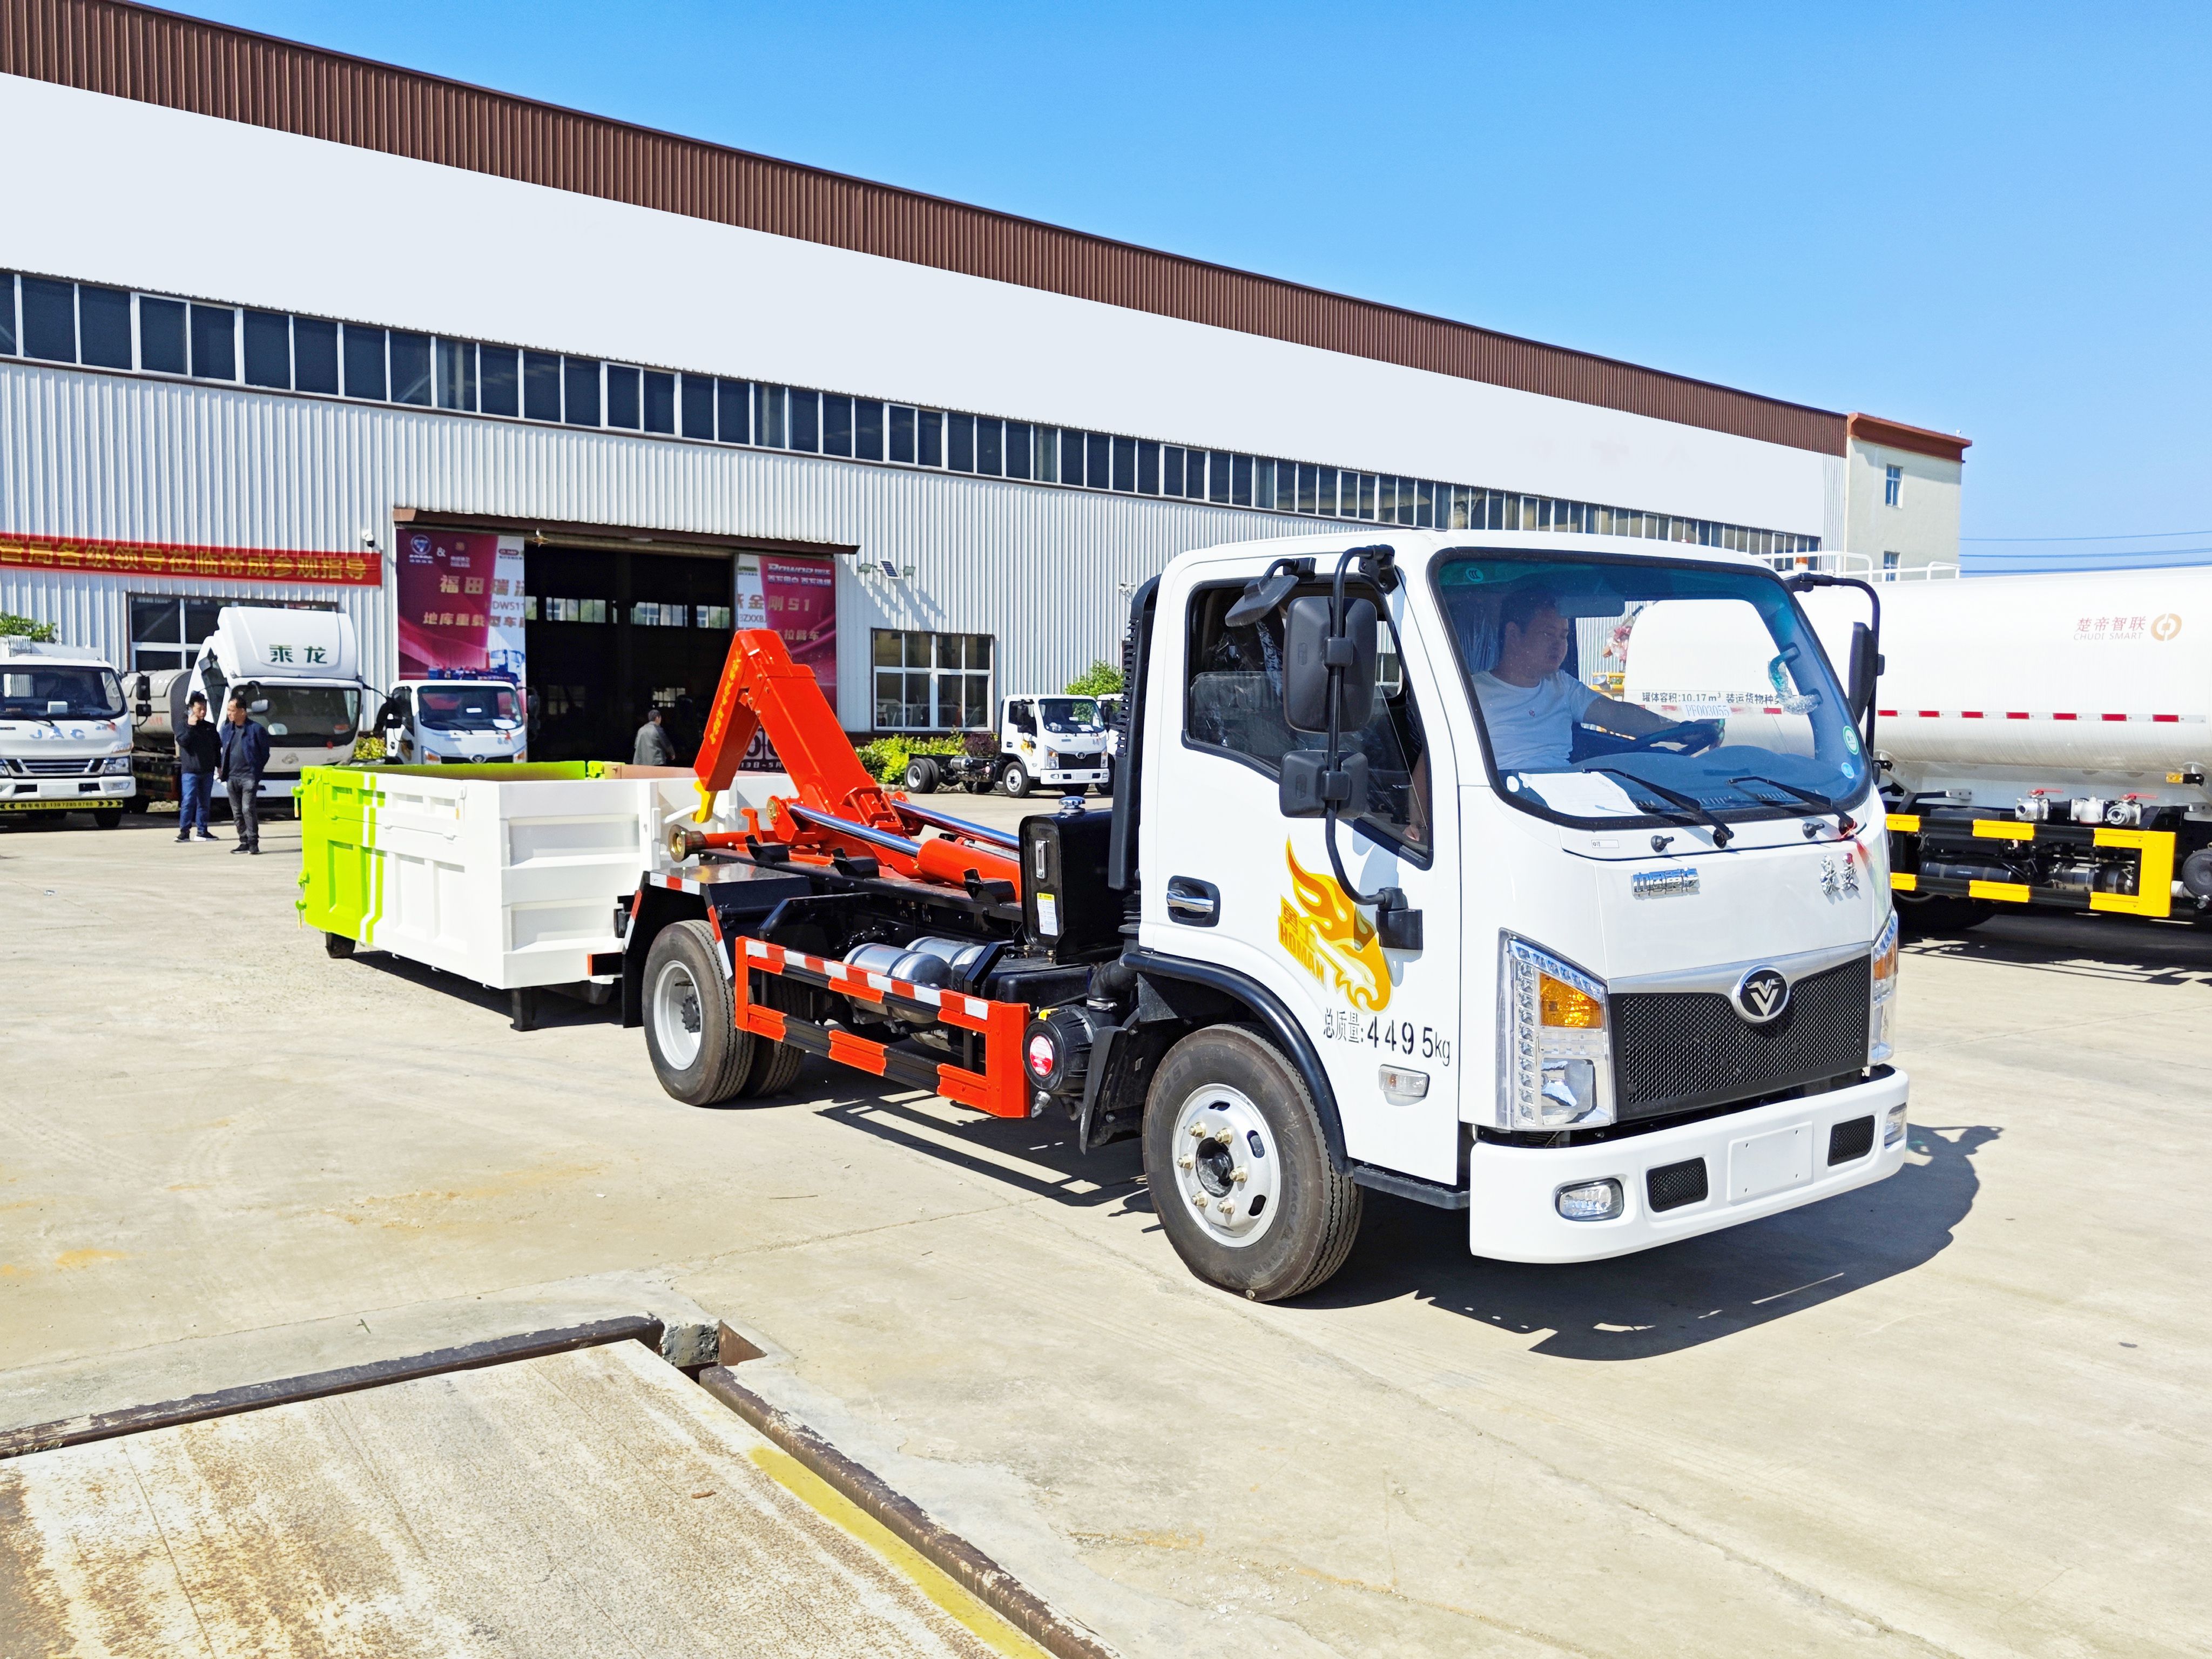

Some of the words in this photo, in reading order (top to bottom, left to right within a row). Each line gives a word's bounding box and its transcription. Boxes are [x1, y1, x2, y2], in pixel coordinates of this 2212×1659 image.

[436, 547, 446, 557] &
[2075, 616, 2147, 632] 楚帝智联
[777, 629, 820, 641] 拉臂车
[2073, 632, 2105, 641] CHUDI
[2109, 632, 2143, 640] SMART
[1685, 703, 1730, 718] PF003055
[29, 727, 86, 740] JAC
[1279, 921, 1325, 986] HOMAN
